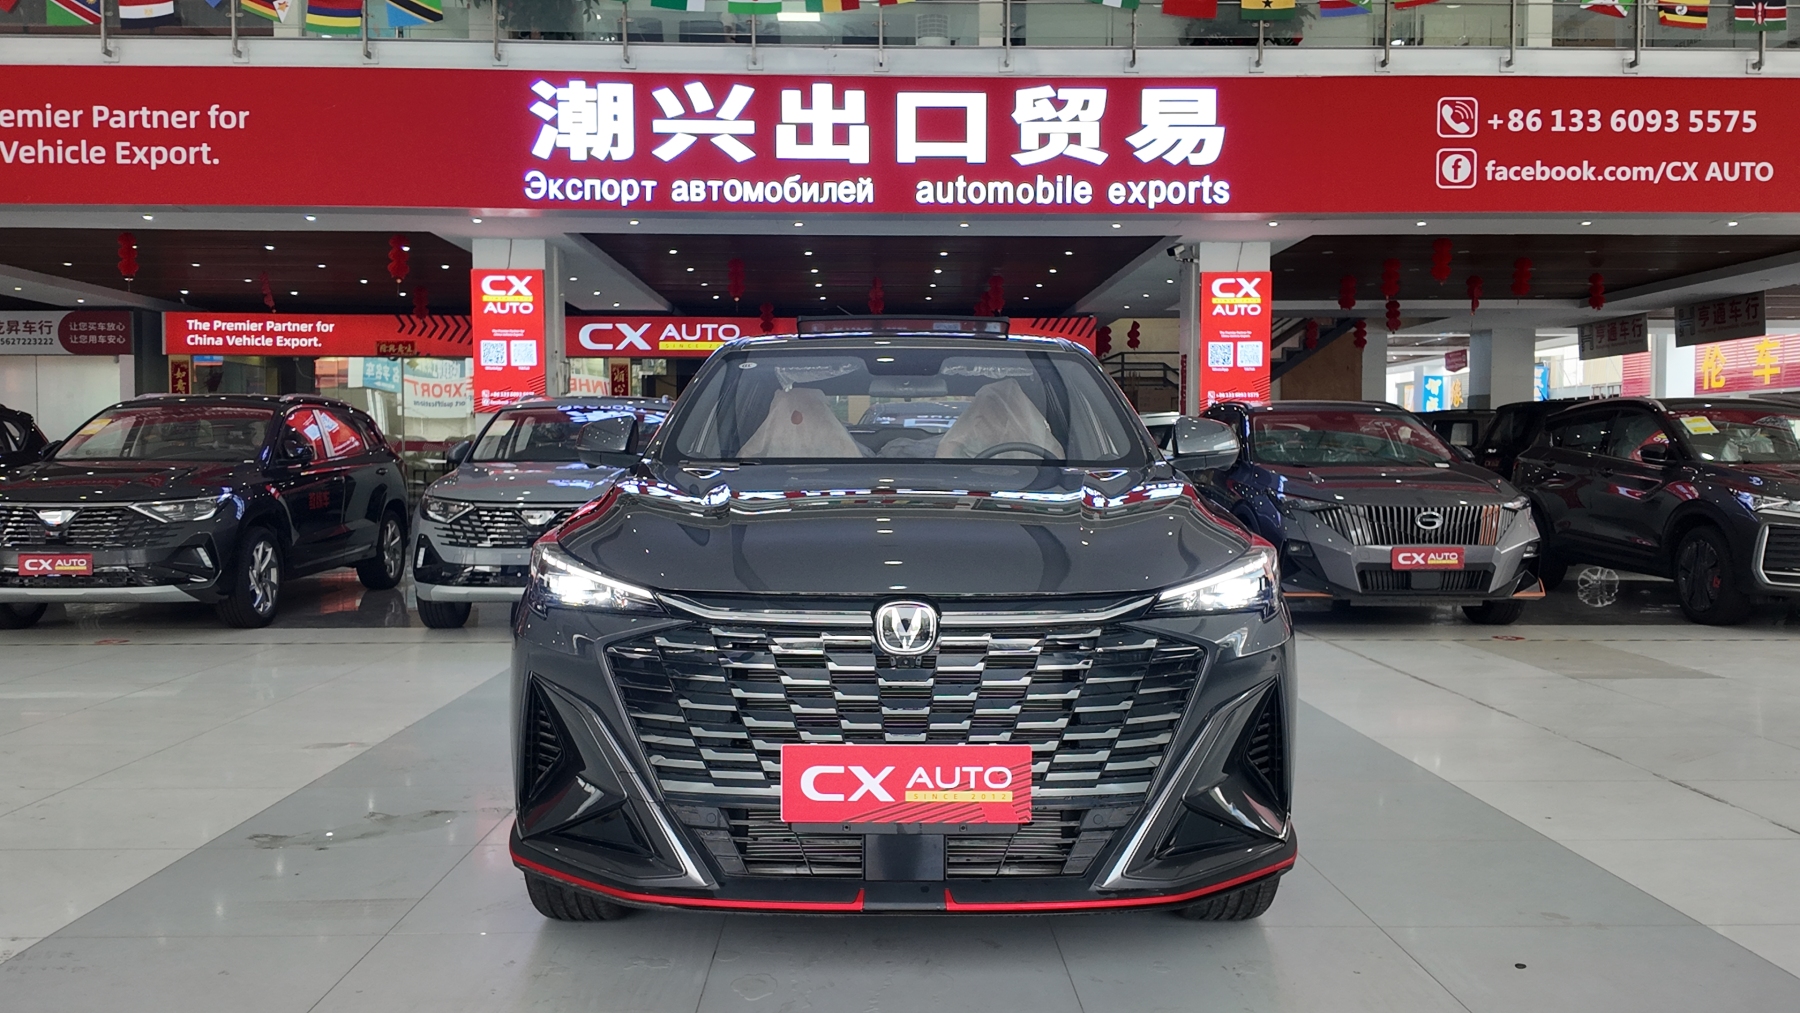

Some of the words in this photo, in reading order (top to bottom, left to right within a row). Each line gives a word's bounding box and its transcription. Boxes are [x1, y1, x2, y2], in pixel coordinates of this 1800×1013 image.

[92, 105, 200, 129] Partner
[208, 104, 250, 129] for
[529, 80, 1226, 166] 潮兴出口贸易
[1487, 109, 1543, 132] +86
[1551, 109, 1601, 132] 133
[1610, 109, 1680, 133] 6093
[1688, 110, 1758, 133] 5575
[0, 139, 106, 164] Vehicle
[116, 142, 220, 170] Export.
[1485, 159, 1698, 184] facebook.com/CX
[1705, 161, 1774, 182] AUTO
[524, 170, 657, 206] Экспорт
[671, 174, 874, 204] автомобилей
[915, 175, 1092, 205] automobile
[1107, 175, 1230, 209] exports
[481, 275, 533, 296] CX
[1211, 278, 1262, 298] CX
[483, 302, 533, 315] AUTO
[1212, 304, 1262, 316] AUTO
[69, 322, 125, 331] 让您买车放心
[186, 319, 210, 331] The
[213, 320, 264, 332] Premier
[266, 321, 313, 333] Partner
[315, 321, 335, 333] for
[578, 323, 652, 350] CX
[659, 324, 741, 341] AUTO
[69, 335, 126, 344] 让您用车安心
[186, 334, 223, 346] China
[226, 335, 273, 347] Vehicle
[276, 336, 322, 349] Export.
[24, 559, 53, 571] CX
[55, 558, 87, 566] AUTO
[1398, 552, 1425, 565] CX
[1428, 552, 1458, 560] AUTO
[800, 765, 895, 802] CX
[905, 766, 1013, 789] AUTO
